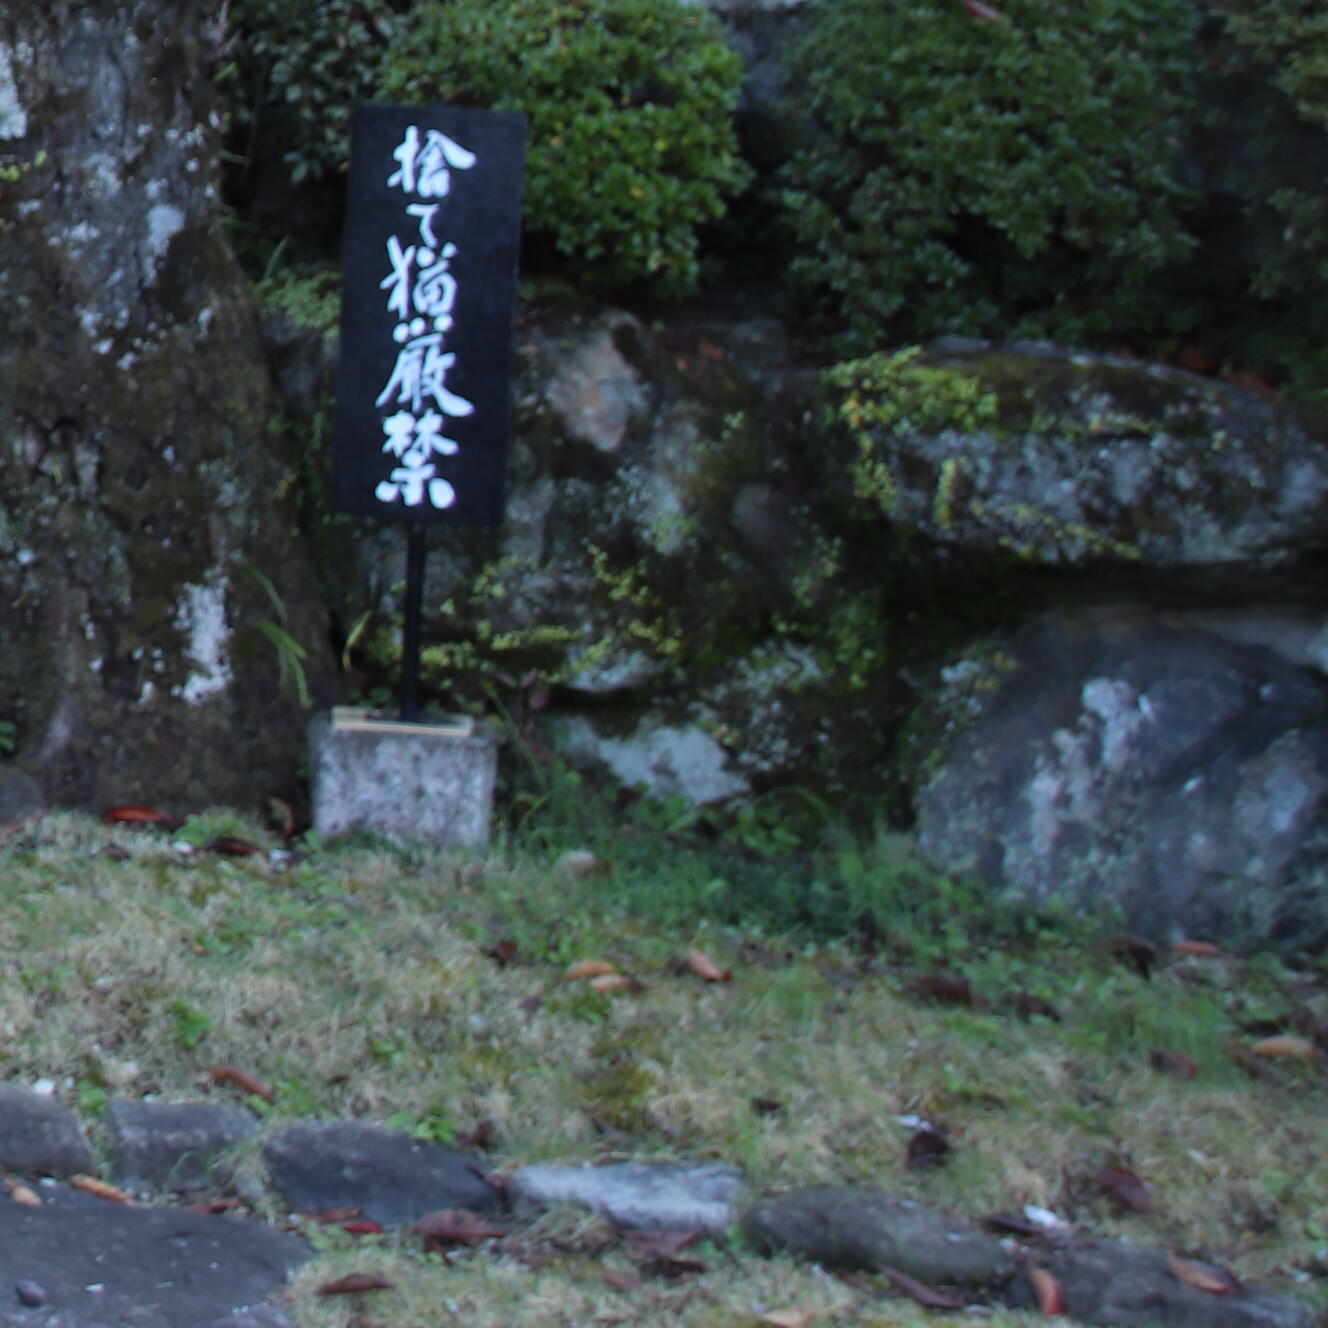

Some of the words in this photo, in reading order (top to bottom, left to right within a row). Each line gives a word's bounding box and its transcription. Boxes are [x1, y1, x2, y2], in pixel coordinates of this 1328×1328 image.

[375, 125, 476, 509] 捨て猫厳禁
